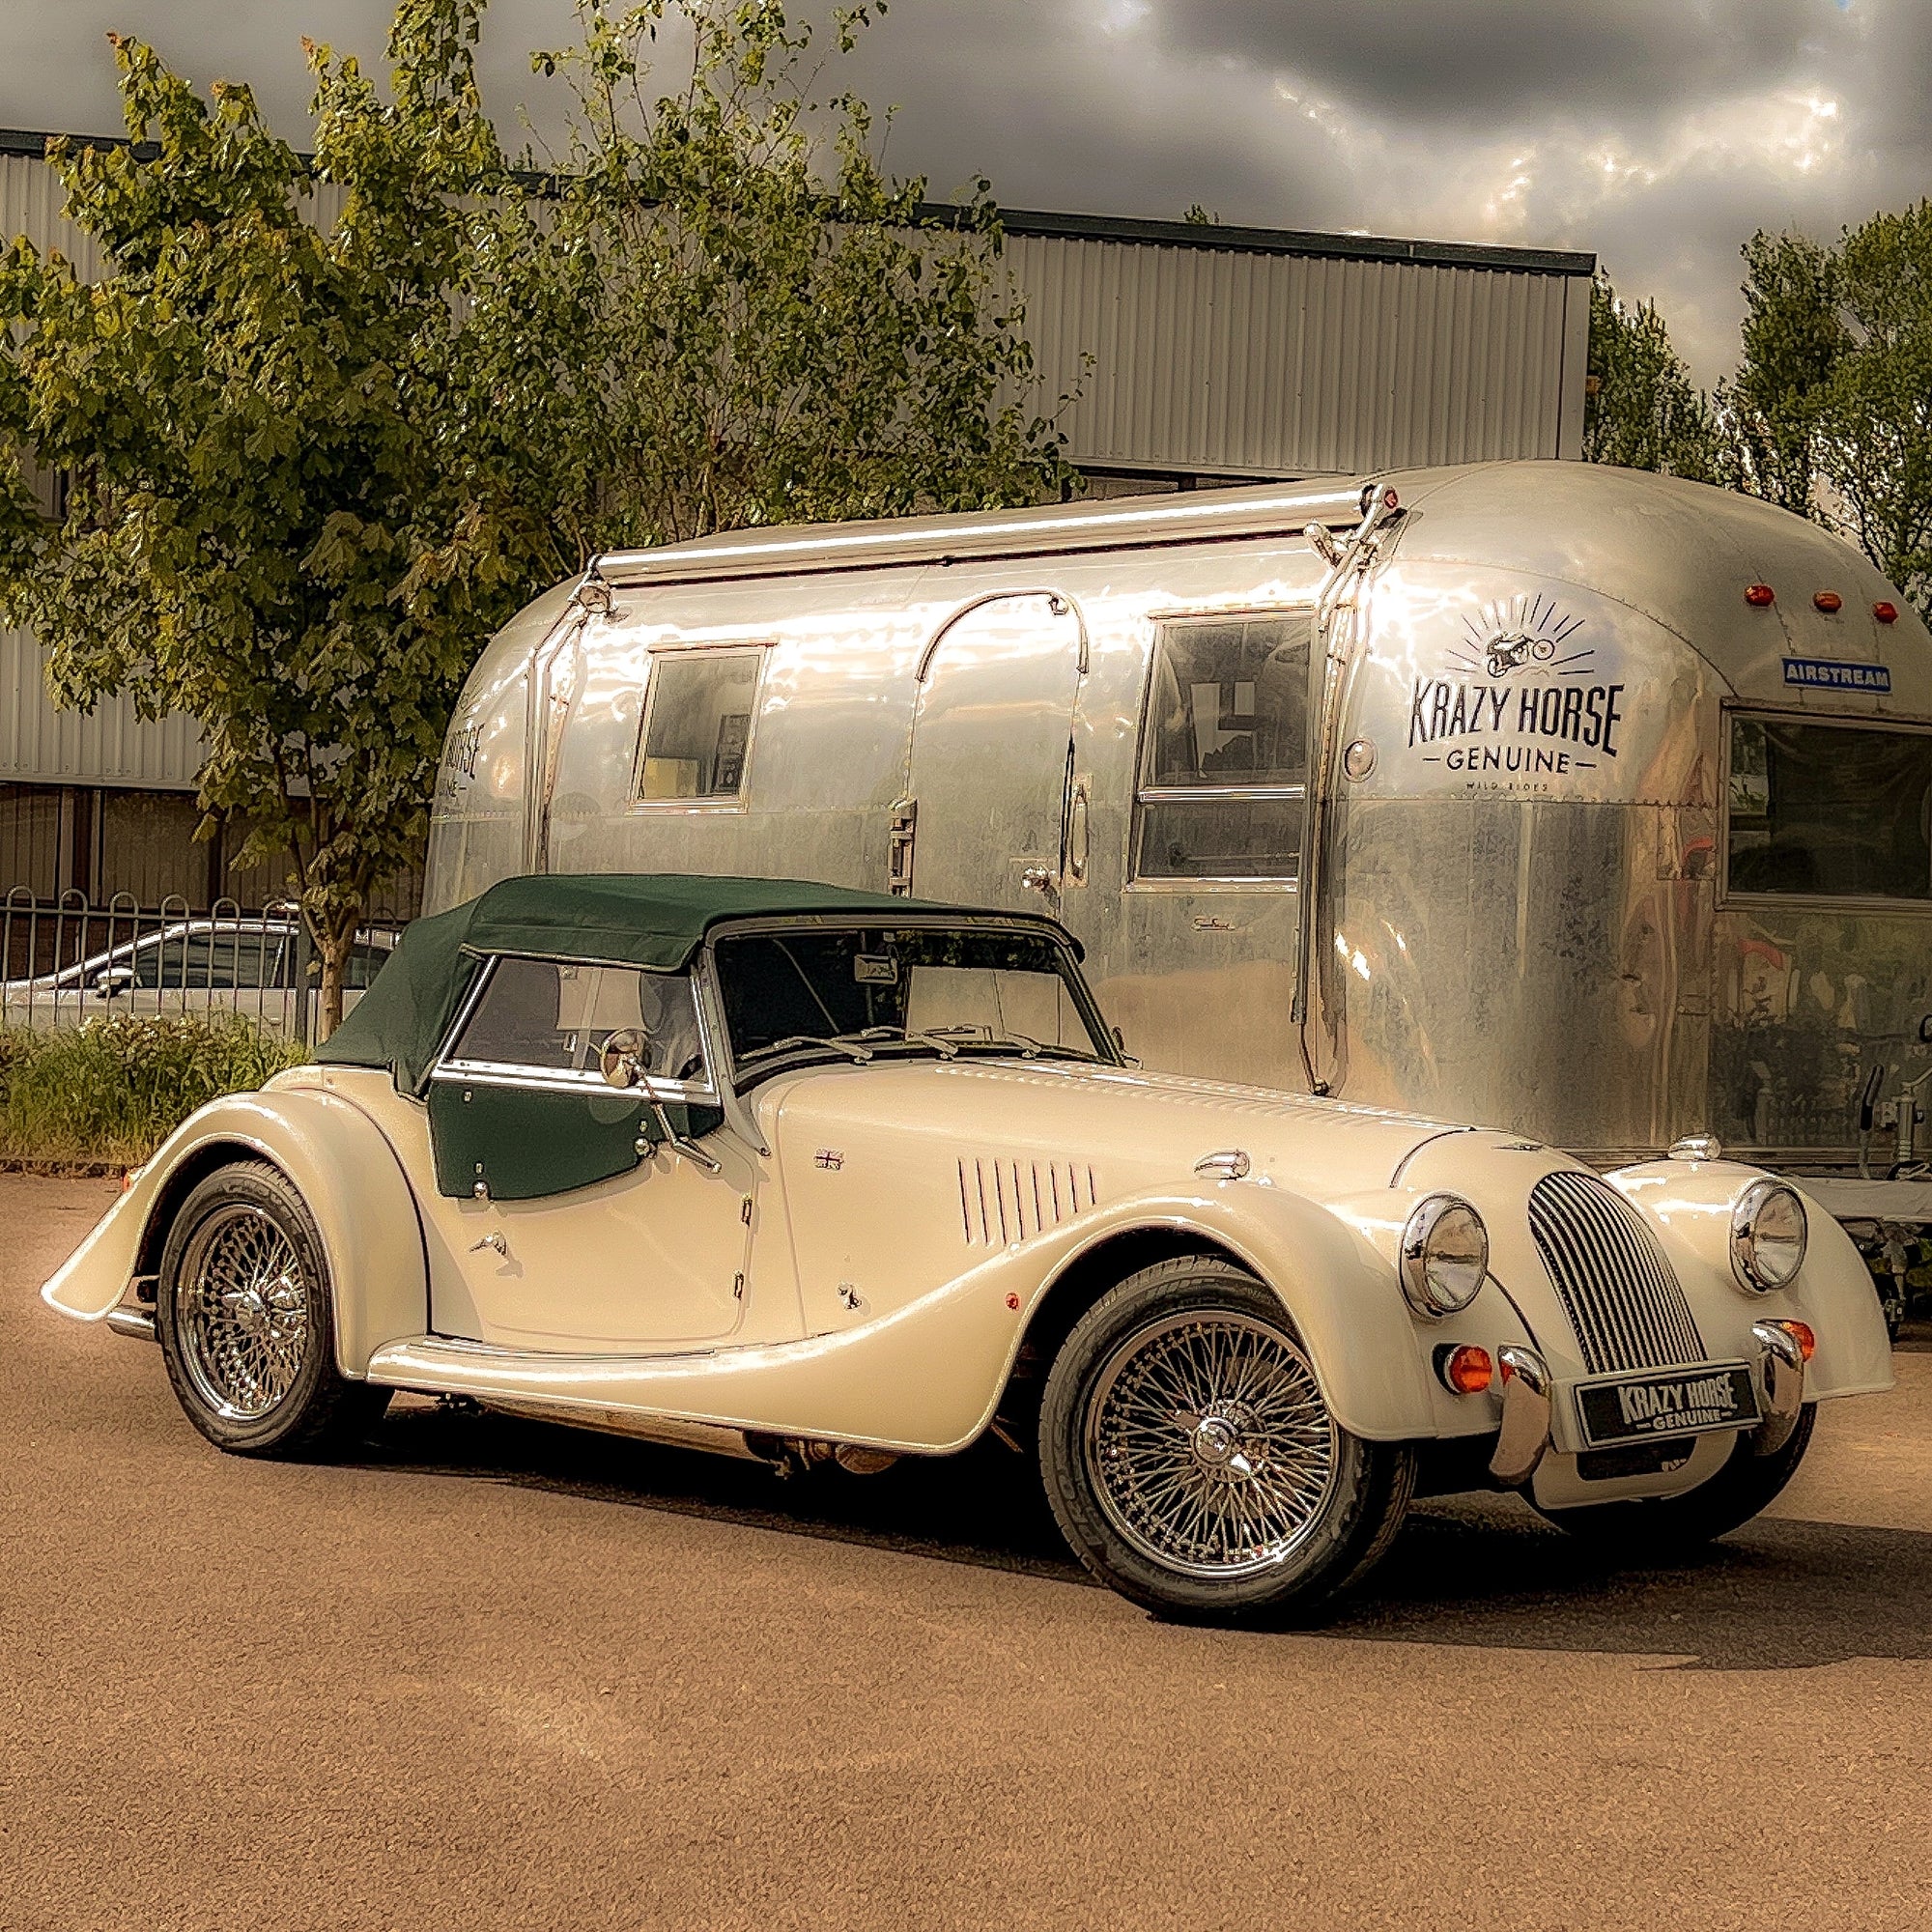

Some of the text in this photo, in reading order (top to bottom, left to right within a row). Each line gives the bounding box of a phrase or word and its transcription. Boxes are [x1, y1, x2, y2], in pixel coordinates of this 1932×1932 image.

[1786, 664, 1889, 688] AIRSTREAM
[1408, 676, 1625, 757] KRAZY HORSE
[1446, 746, 1571, 775] GENUINE
[1618, 1372, 1739, 1425] KRAZY HORSE
[1653, 1409, 1721, 1430] GENUINE
